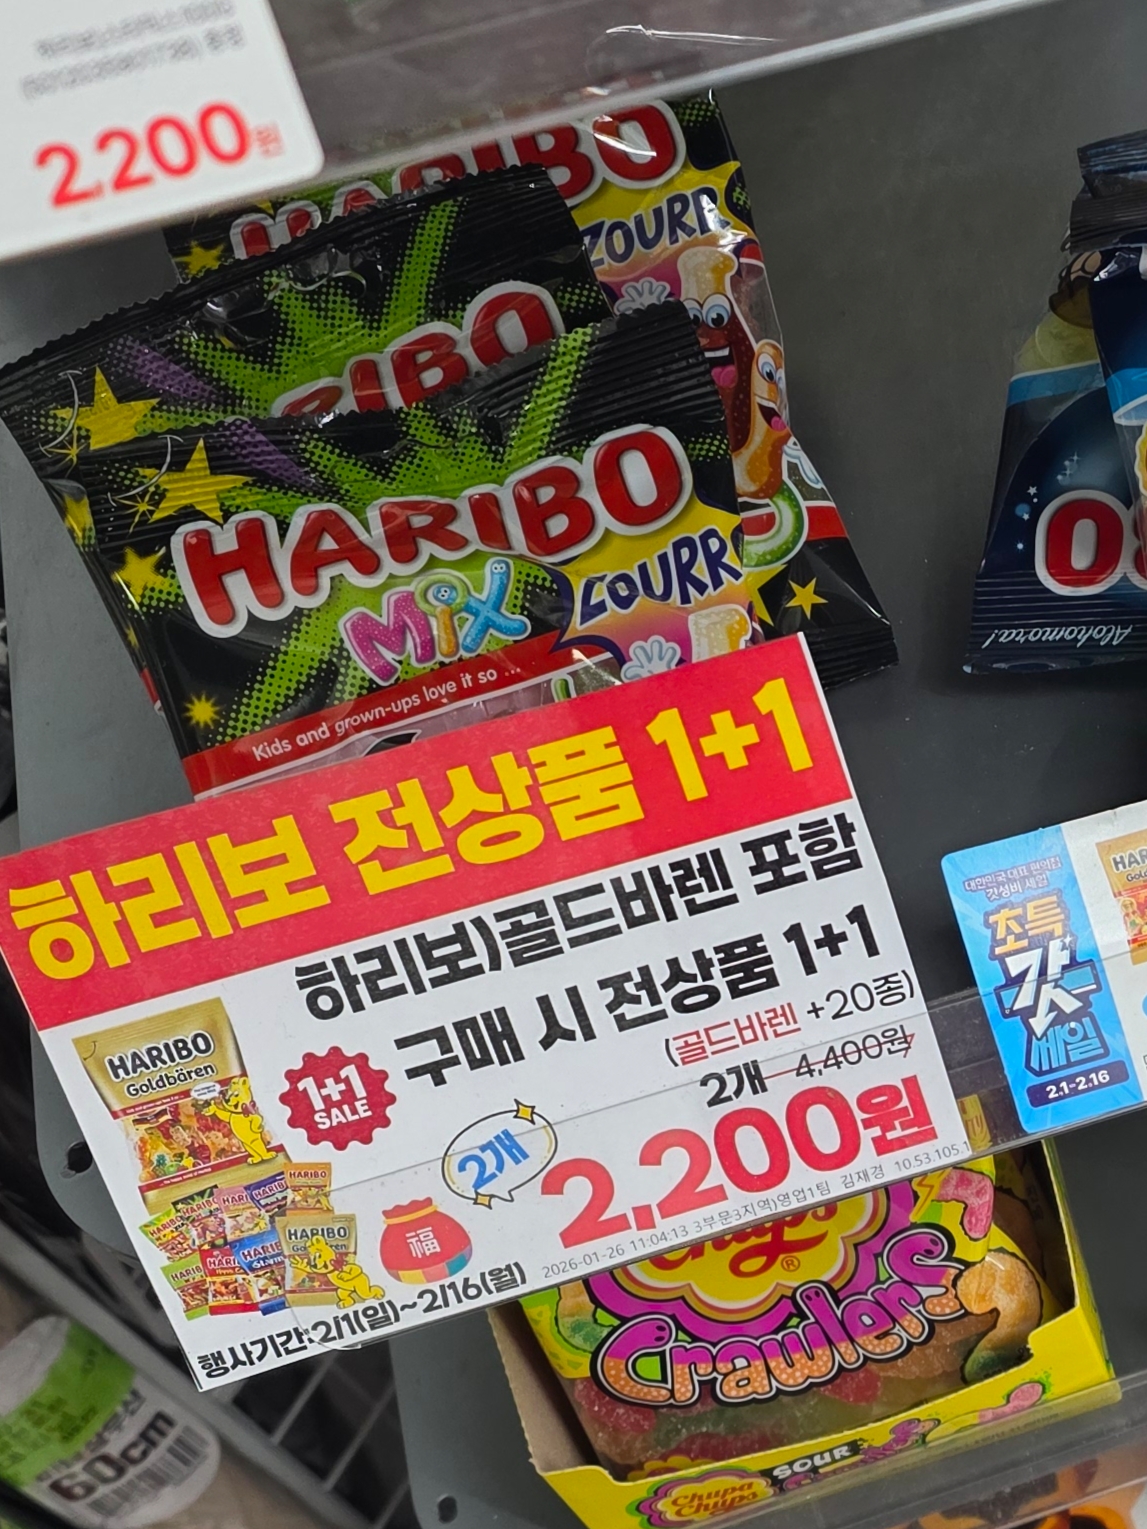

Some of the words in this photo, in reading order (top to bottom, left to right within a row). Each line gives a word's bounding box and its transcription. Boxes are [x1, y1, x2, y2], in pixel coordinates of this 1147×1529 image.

[175, 426, 690, 635] HARIBO
[981, 623, 1134, 650] Alohomora!
[252, 738, 292, 762] Kids
[297, 723, 331, 744] and
[335, 693, 422, 738] grown-ups
[425, 677, 458, 702] love
[461, 672, 474, 688] it
[477, 670, 498, 686] so
[8, 814, 332, 980] 하리보
[328, 725, 645, 896] 전상품
[645, 677, 814, 802] 1+1
[965, 868, 1008, 892] 대한민국
[985, 883, 1023, 902] 갓성비
[1023, 874, 1049, 890] 세일
[295, 848, 740, 1021] 하리보)골드바렌
[741, 812, 864, 896] 포함
[988, 895, 1065, 956] 초특
[394, 1004, 526, 1088] 구매
[535, 985, 597, 1053] 시
[597, 932, 781, 1033] 전상품
[783, 904, 881, 977] 1+1
[664, 1002, 802, 1067] (골드바렌
[806, 969, 916, 1022] +20종)
[107, 1031, 215, 1080] HARIBO
[126, 1063, 216, 1100] Goldbären
[700, 1058, 768, 1109] 2개
[795, 1024, 912, 1080] 4,400원
[298, 1064, 369, 1112] 1+1
[1045, 1069, 1110, 1100] 2.1-2.16
[313, 1098, 373, 1131] SALE
[289, 1169, 327, 1181] HARIBO
[457, 1128, 530, 1190] 2개
[540, 1074, 939, 1249] 2,200원
[406, 1227, 442, 1260] 福
[542, 1243, 626, 1280] 2026-01-26
[629, 1224, 690, 1255] 11:04:13
[694, 1180, 832, 1237] 3부문3지역)영업1팀
[841, 1163, 887, 1190] 김재경
[598, 1229, 966, 1402] Crawlers
[48, 1410, 177, 1502] 60cm
[772, 1445, 851, 1480] SOUR
[671, 1481, 753, 1507] Chupa
[674, 1491, 759, 1518] Chups
